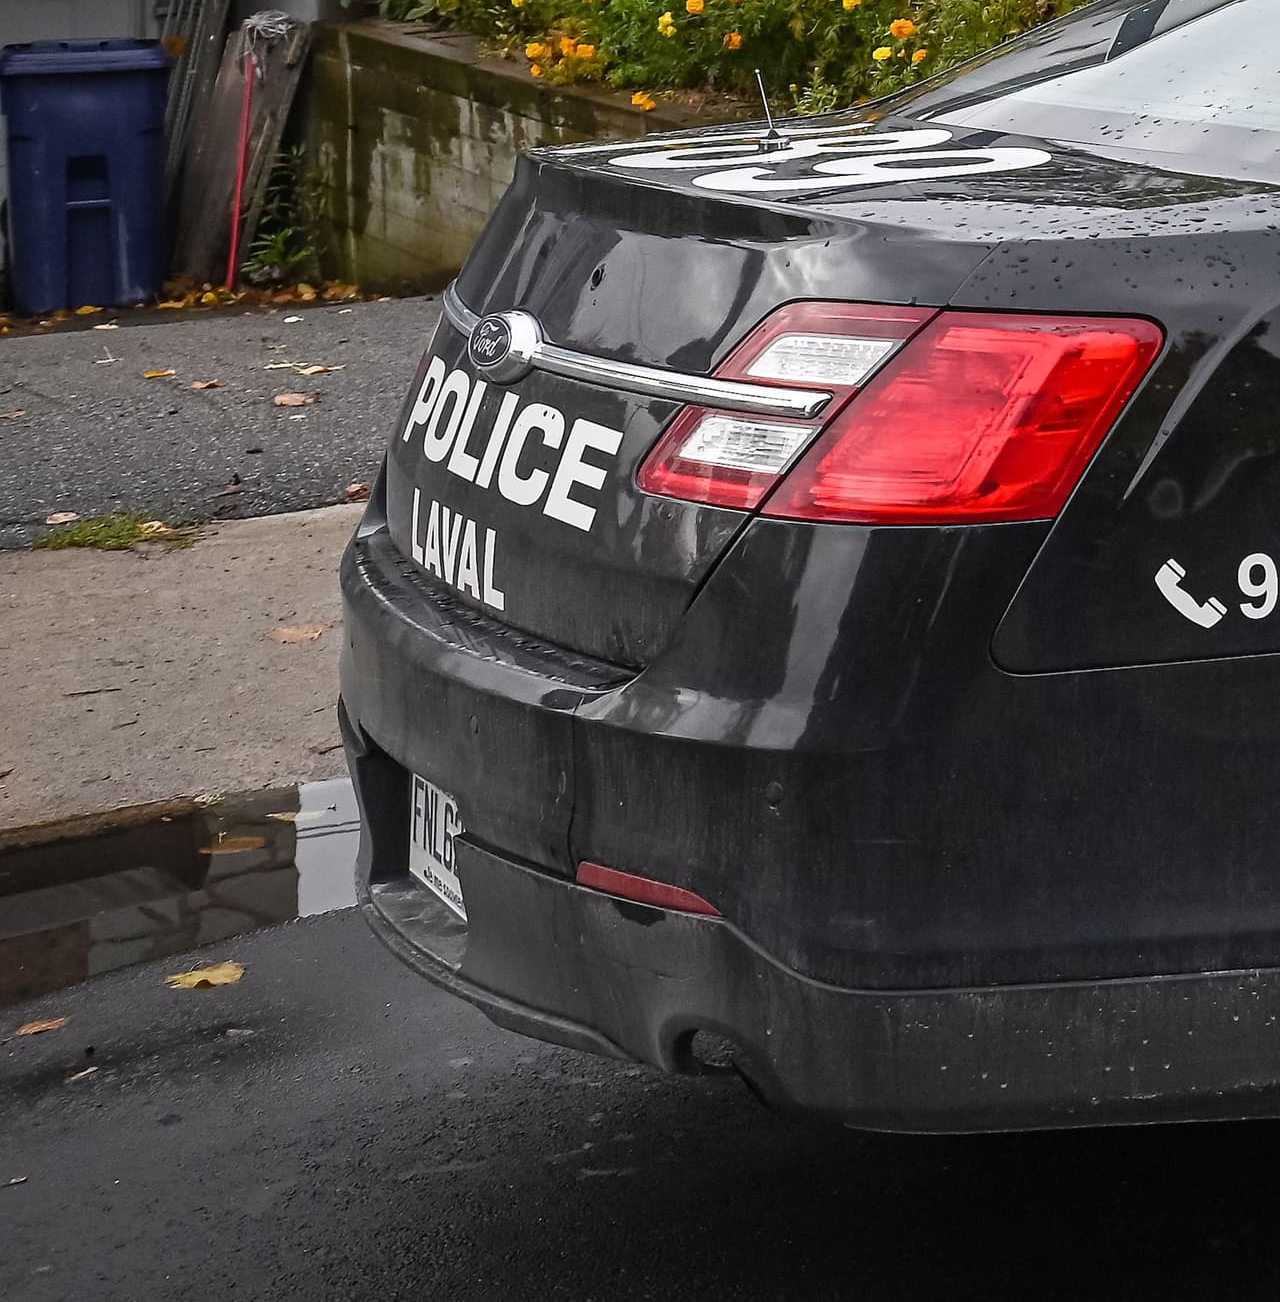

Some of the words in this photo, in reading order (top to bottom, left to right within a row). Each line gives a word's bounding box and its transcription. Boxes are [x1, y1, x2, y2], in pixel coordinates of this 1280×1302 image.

[473, 321, 503, 357] Ford
[402, 354, 624, 533] POLICE
[411, 487, 505, 611] LAVAL
